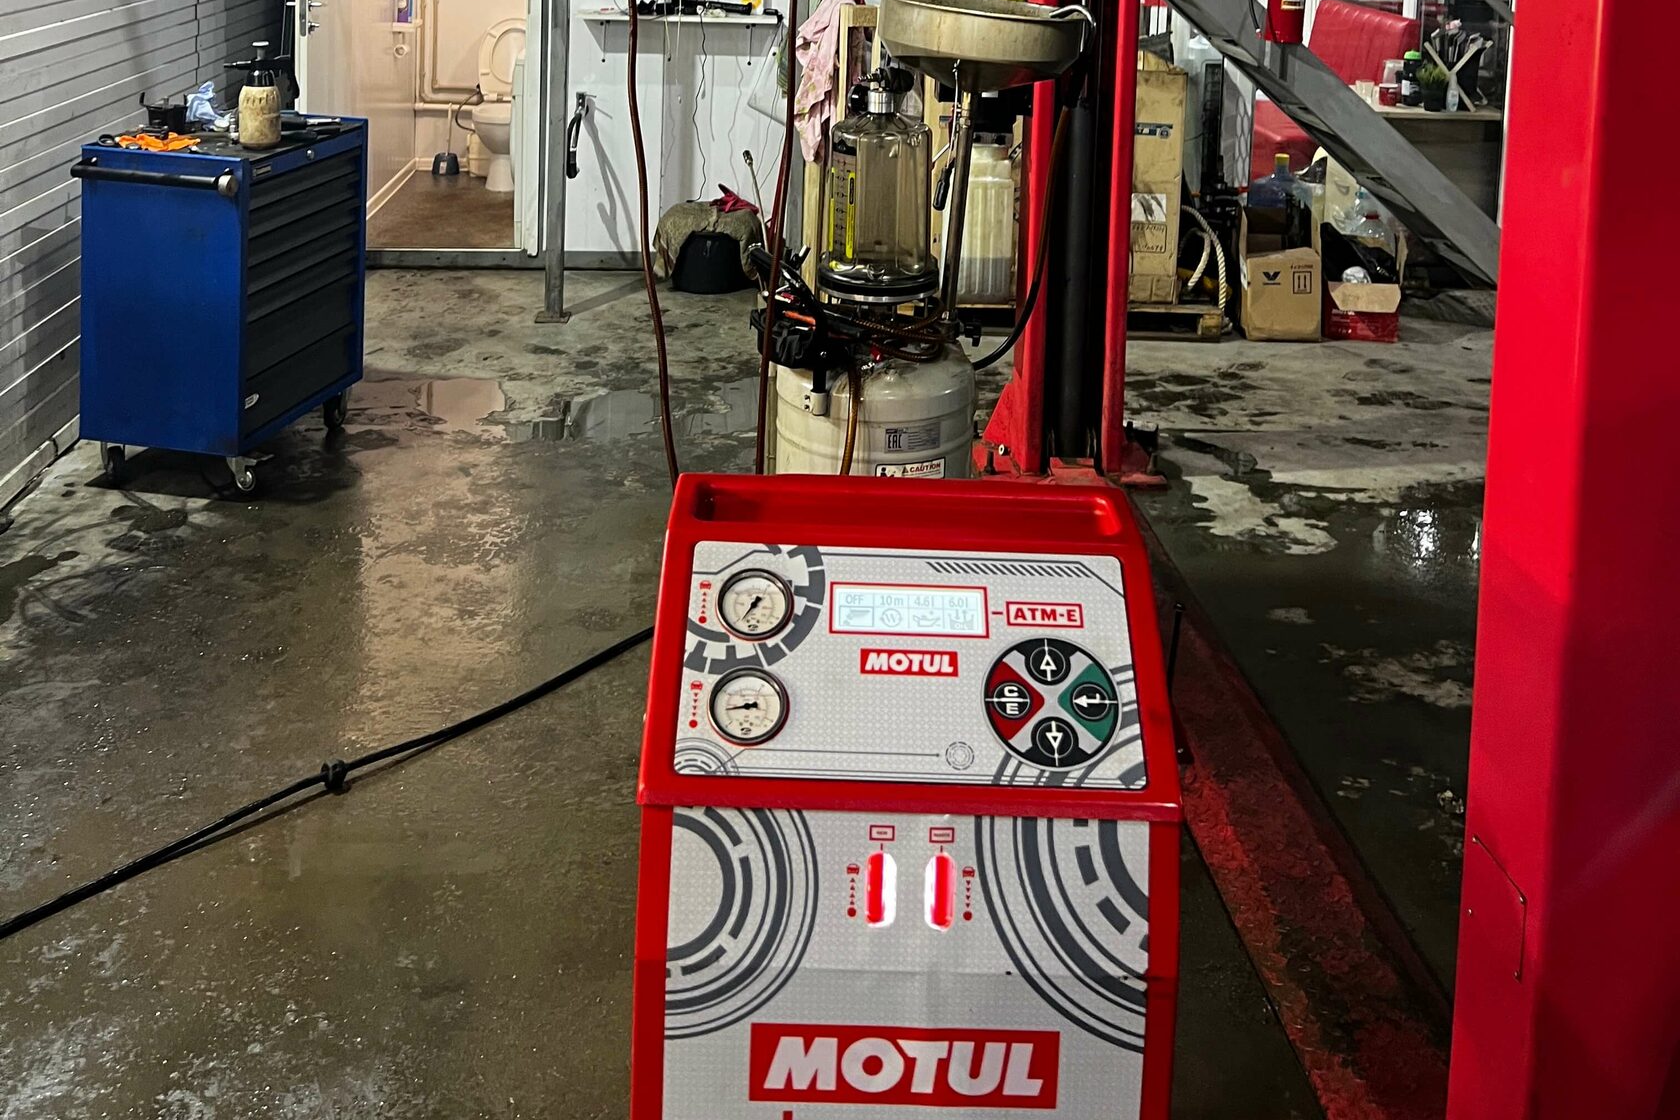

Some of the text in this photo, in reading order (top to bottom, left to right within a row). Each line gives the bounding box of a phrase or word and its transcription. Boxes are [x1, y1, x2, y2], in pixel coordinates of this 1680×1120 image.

[909, 462, 941, 473] CAUTION
[845, 594, 864, 605] OFF
[1013, 607, 1078, 622] ATM-E
[865, 652, 954, 673] MOTUL
[763, 1036, 1044, 1097] MOTUL
